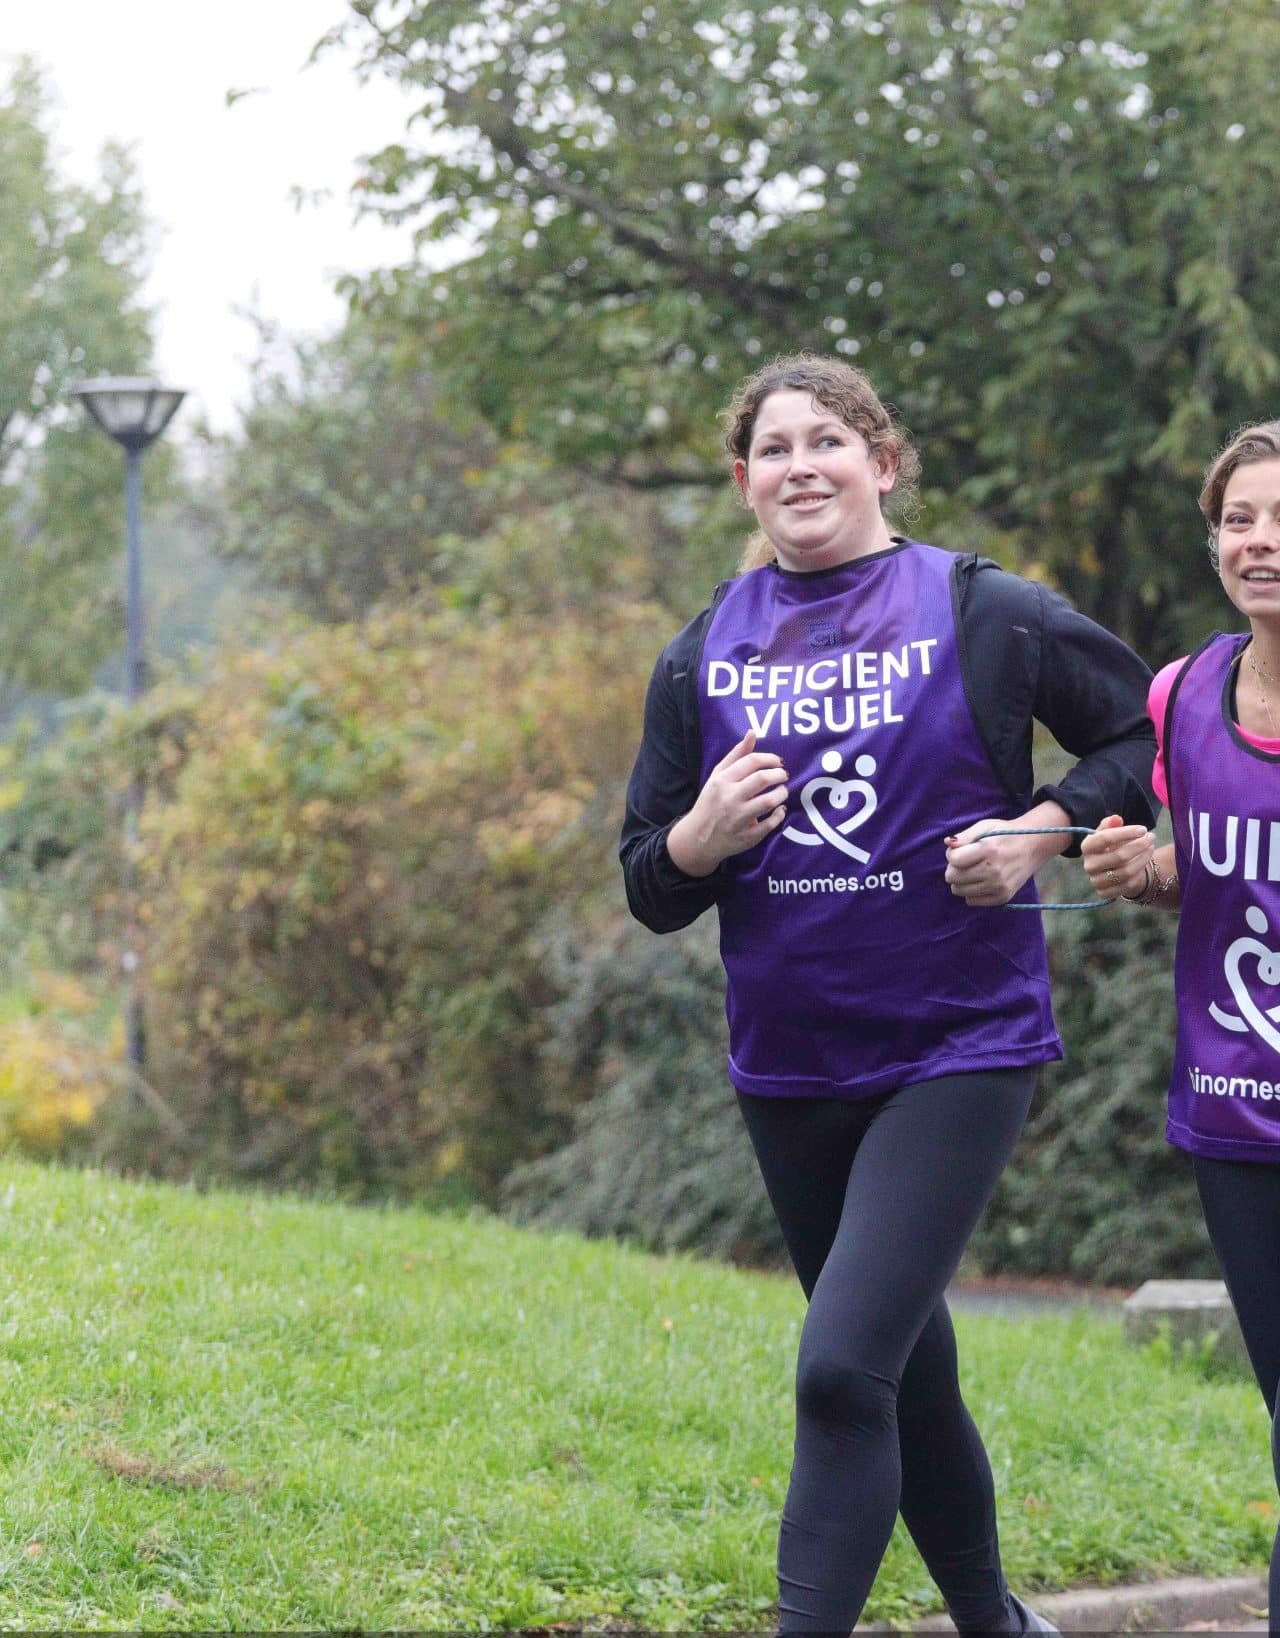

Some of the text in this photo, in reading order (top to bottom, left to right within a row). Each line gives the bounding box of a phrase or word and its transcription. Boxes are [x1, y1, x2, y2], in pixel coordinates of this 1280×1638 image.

[707, 638, 938, 698] DÉFICIENT
[745, 690, 904, 738] VISUEL
[768, 870, 904, 894] binomes.org
